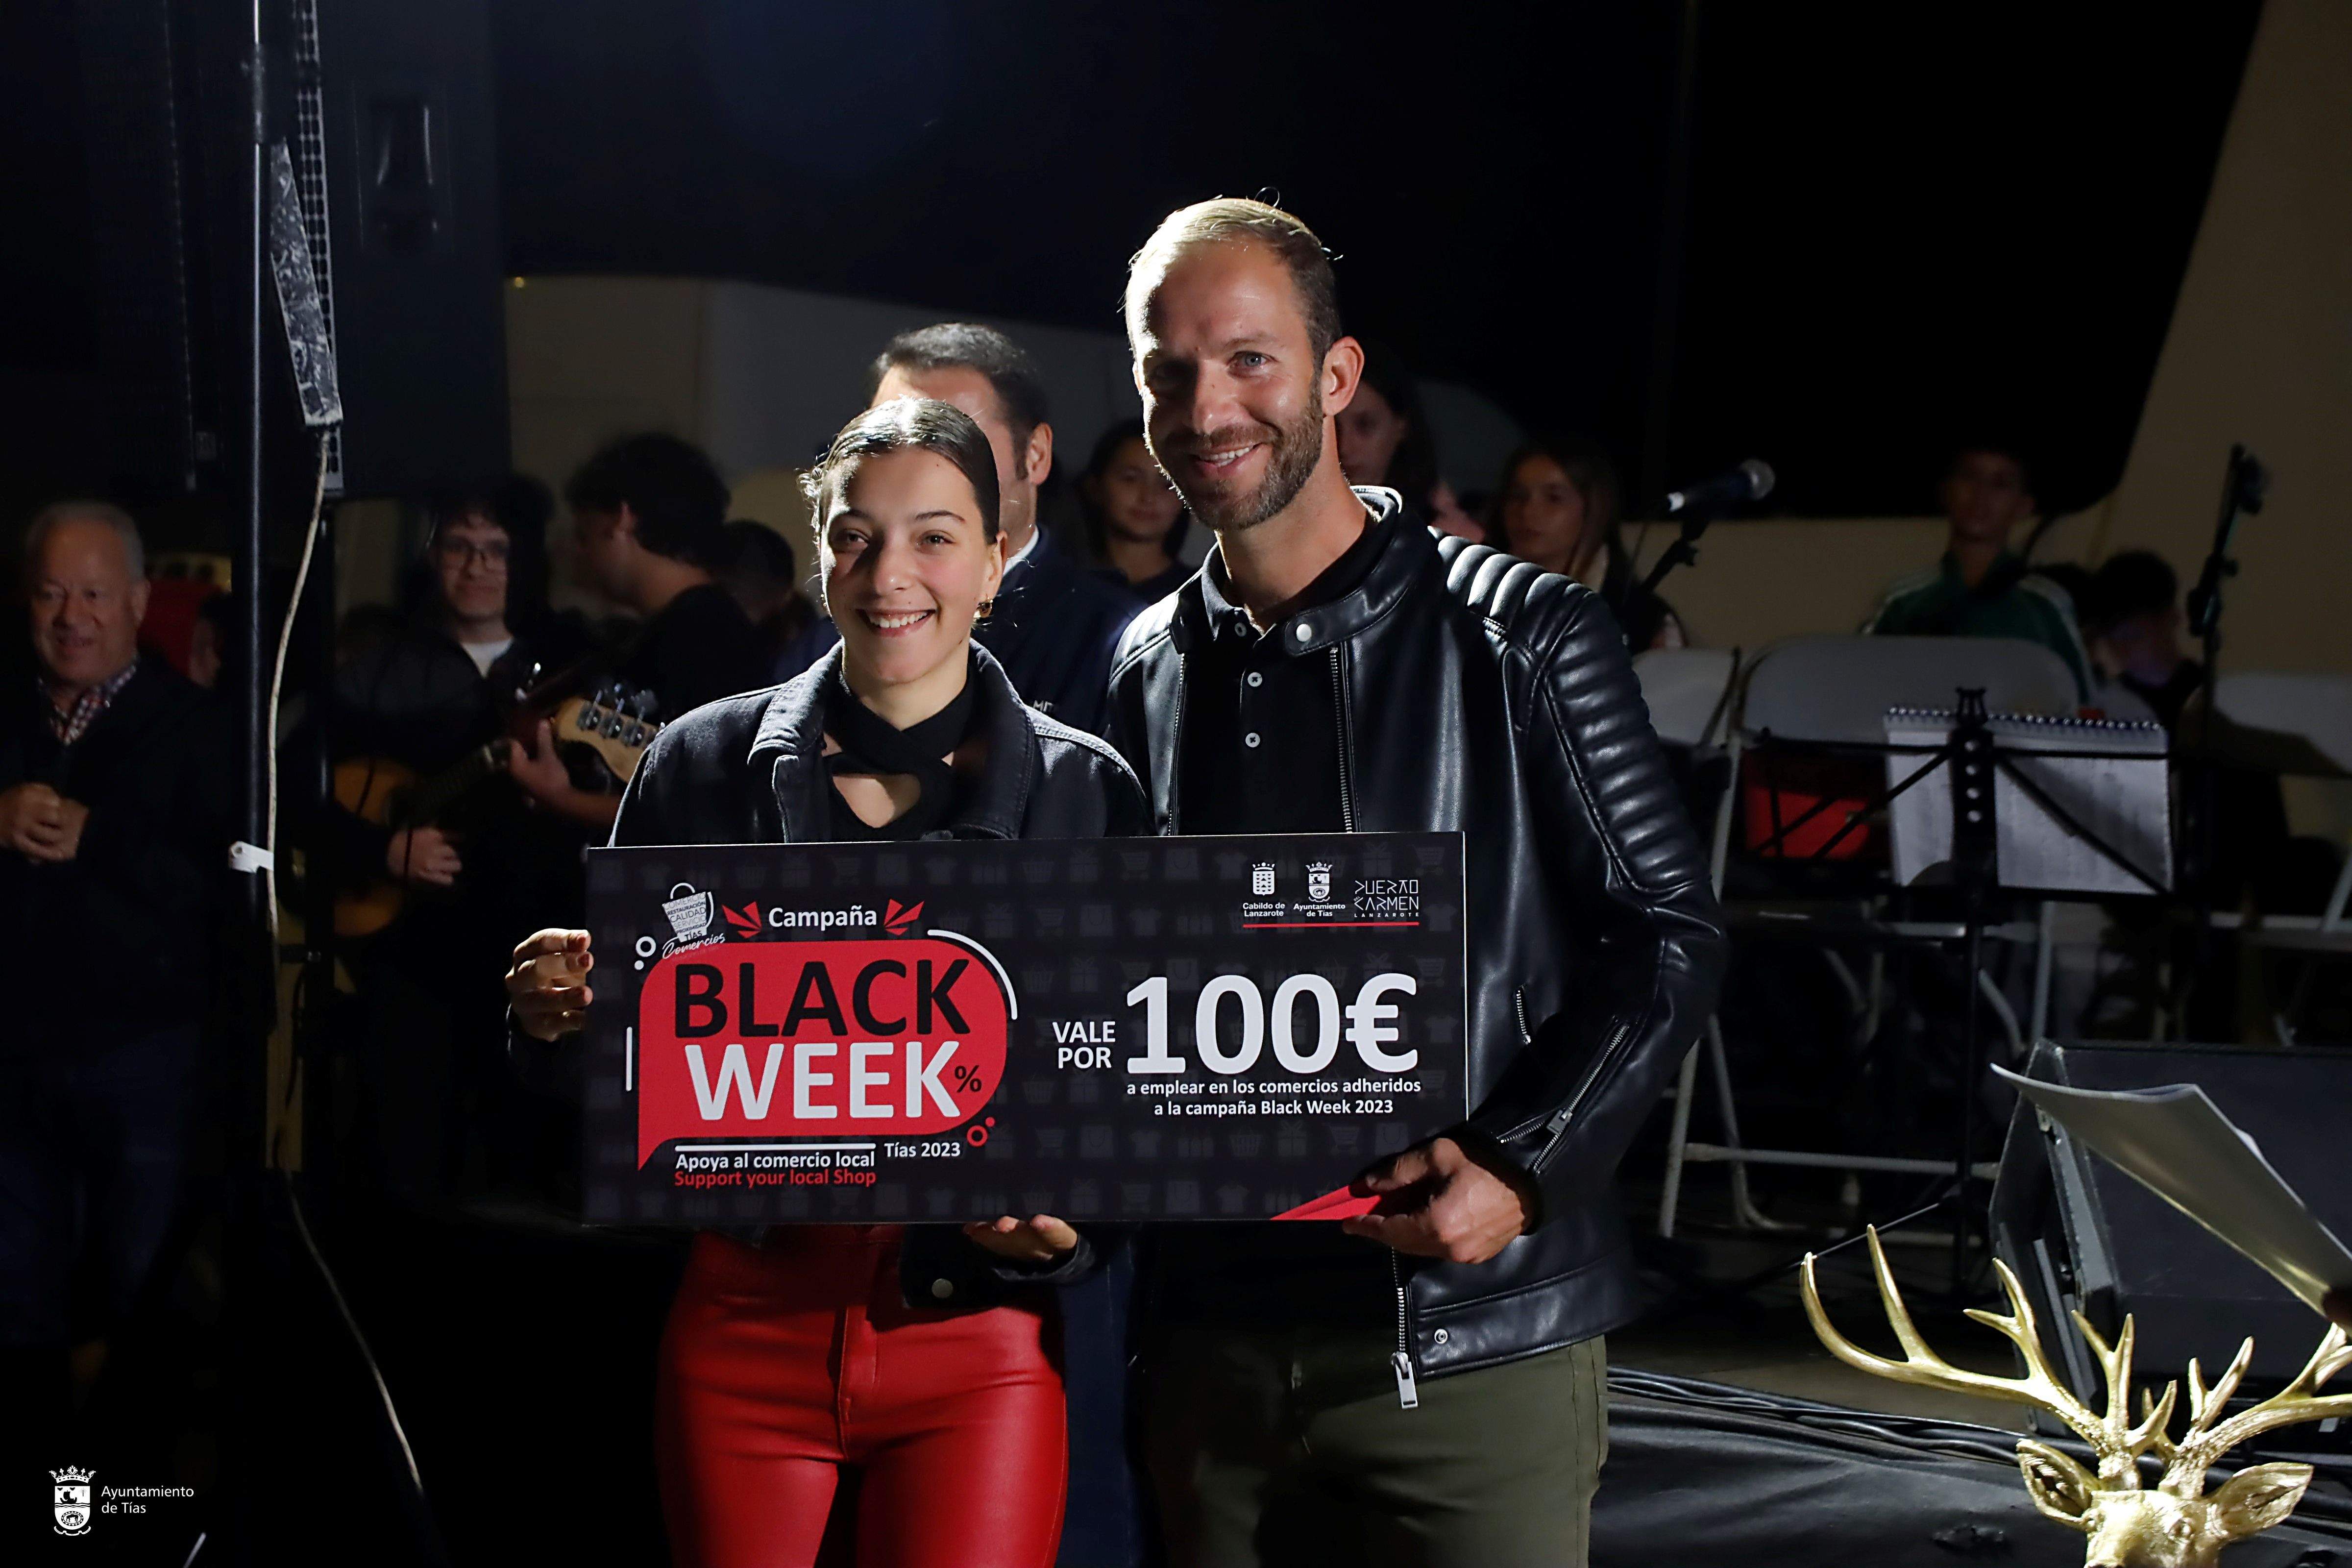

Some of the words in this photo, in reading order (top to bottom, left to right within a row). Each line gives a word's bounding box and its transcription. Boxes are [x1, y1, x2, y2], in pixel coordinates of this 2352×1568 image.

[665, 892, 706, 910] COMERCIO
[1354, 896, 1419, 910] CARMEN
[670, 907, 706, 923] CALIDAD
[674, 915, 706, 930] SERVICIO
[768, 905, 877, 931] Campaña
[662, 933, 726, 959] Comercios
[685, 931, 703, 940] TÍAS
[675, 959, 971, 1038] BLACK
[1052, 1021, 1116, 1043] VALE
[1127, 973, 1418, 1075] 100€
[1058, 1047, 1112, 1069] POR
[685, 1041, 961, 1121] WEEK
[955, 1065, 982, 1093] %
[1127, 1083, 1136, 1095] a
[1140, 1079, 1205, 1098] emplear
[1209, 1083, 1228, 1094] en
[1233, 1079, 1255, 1094] los
[1259, 1078, 1338, 1093] comercios
[1343, 1078, 1421, 1093] adheridos
[1154, 1104, 1163, 1115] a
[1168, 1101, 1181, 1115] la
[1186, 1100, 1256, 1118] campaña
[1261, 1100, 1302, 1114] Black
[1306, 1099, 1351, 1114] Week
[1355, 1100, 1393, 1113] 2023
[884, 1142, 916, 1157] Tías
[921, 1142, 960, 1157] 2023
[675, 1154, 729, 1173] Apoya
[734, 1152, 748, 1168] al
[753, 1152, 831, 1168] comercio
[836, 1151, 875, 1167] local
[675, 1170, 742, 1189] Support
[746, 1174, 785, 1189] your
[790, 1169, 829, 1185] local
[833, 1168, 876, 1187] Shop
